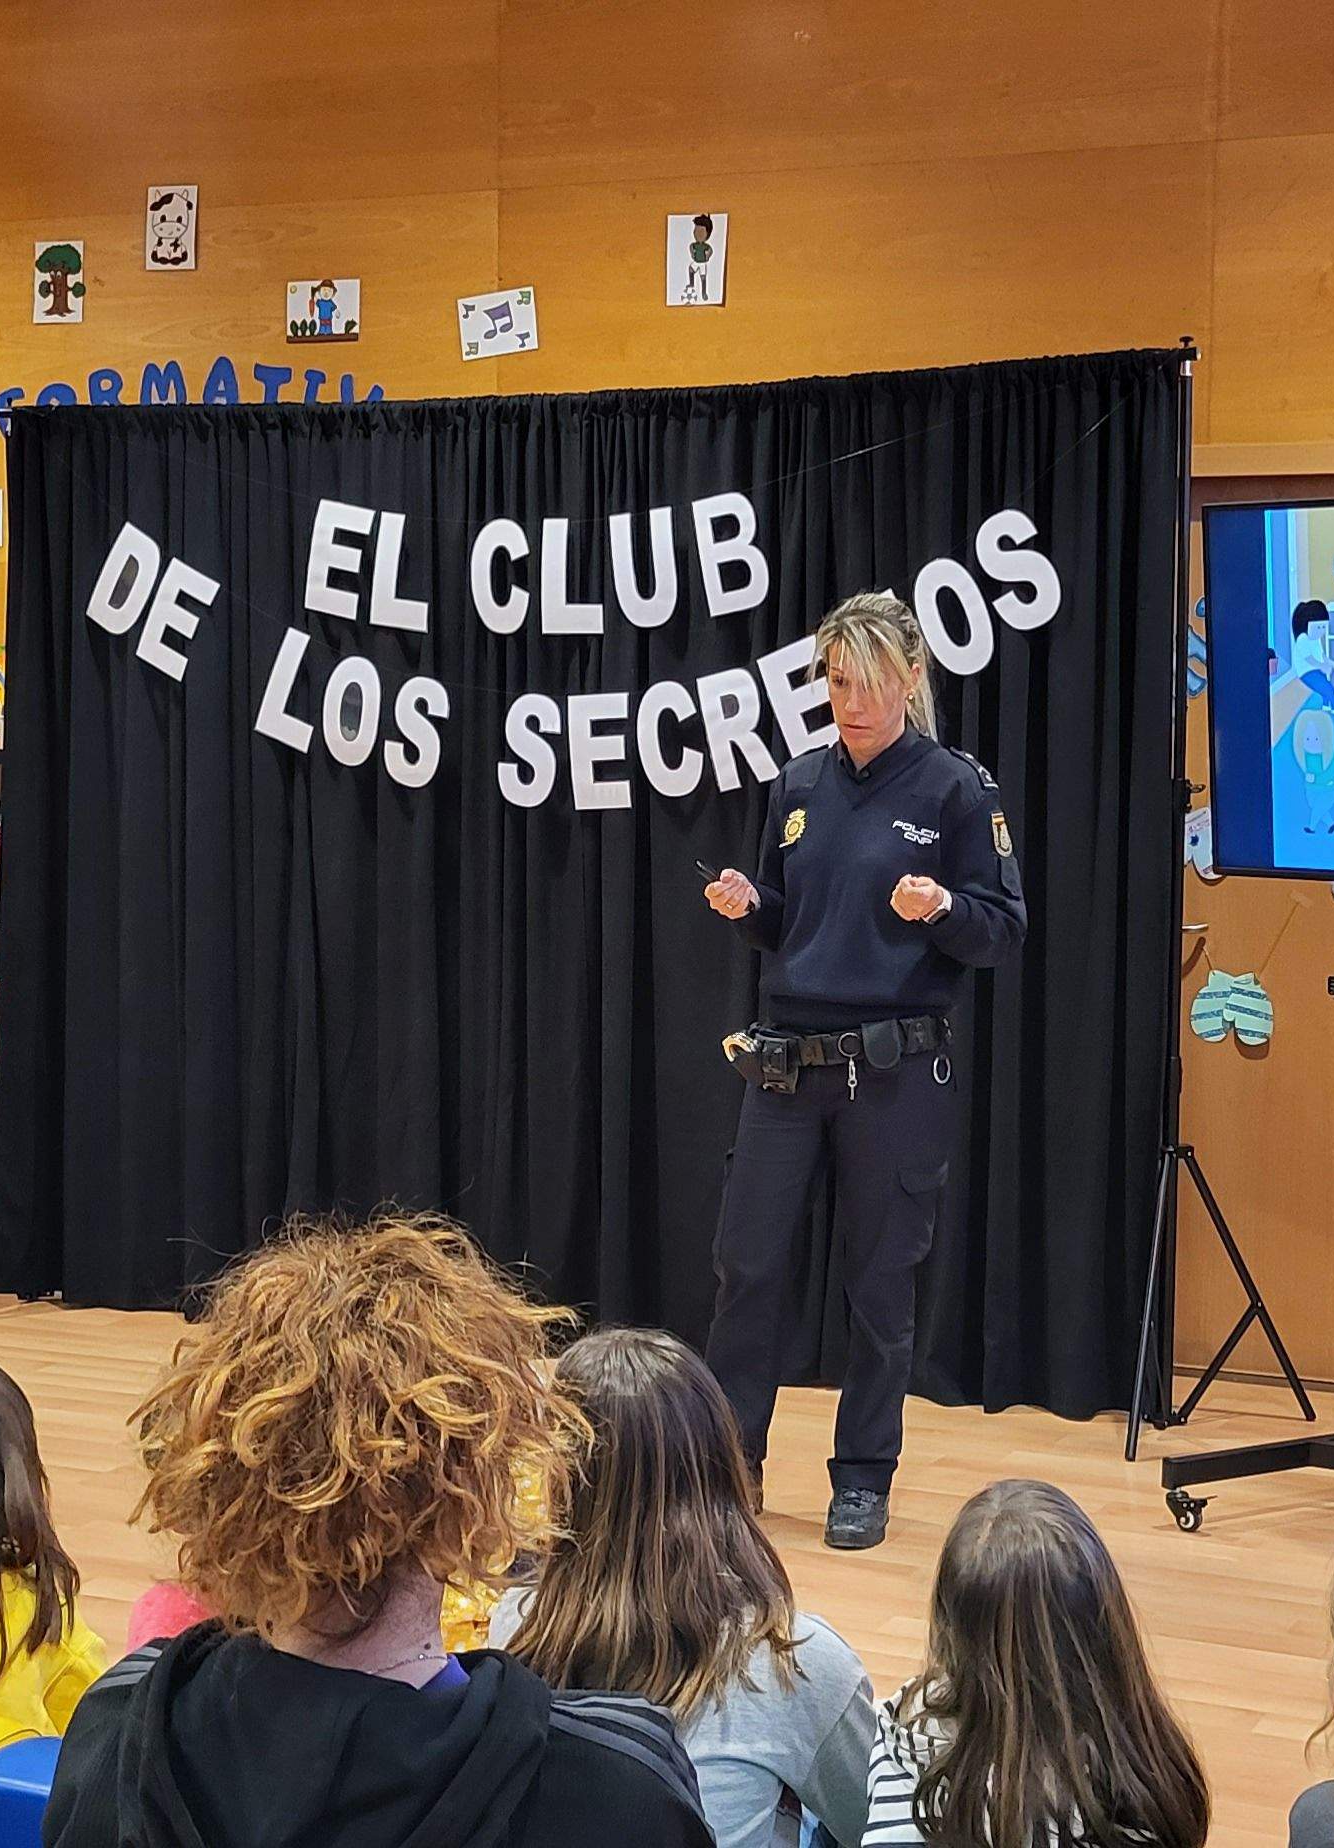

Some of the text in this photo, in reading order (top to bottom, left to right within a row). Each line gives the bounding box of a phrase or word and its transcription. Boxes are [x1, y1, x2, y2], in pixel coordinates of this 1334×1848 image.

[85, 508, 1061, 811] DE LOS SECREOS
[304, 492, 769, 635] EL CLUB
